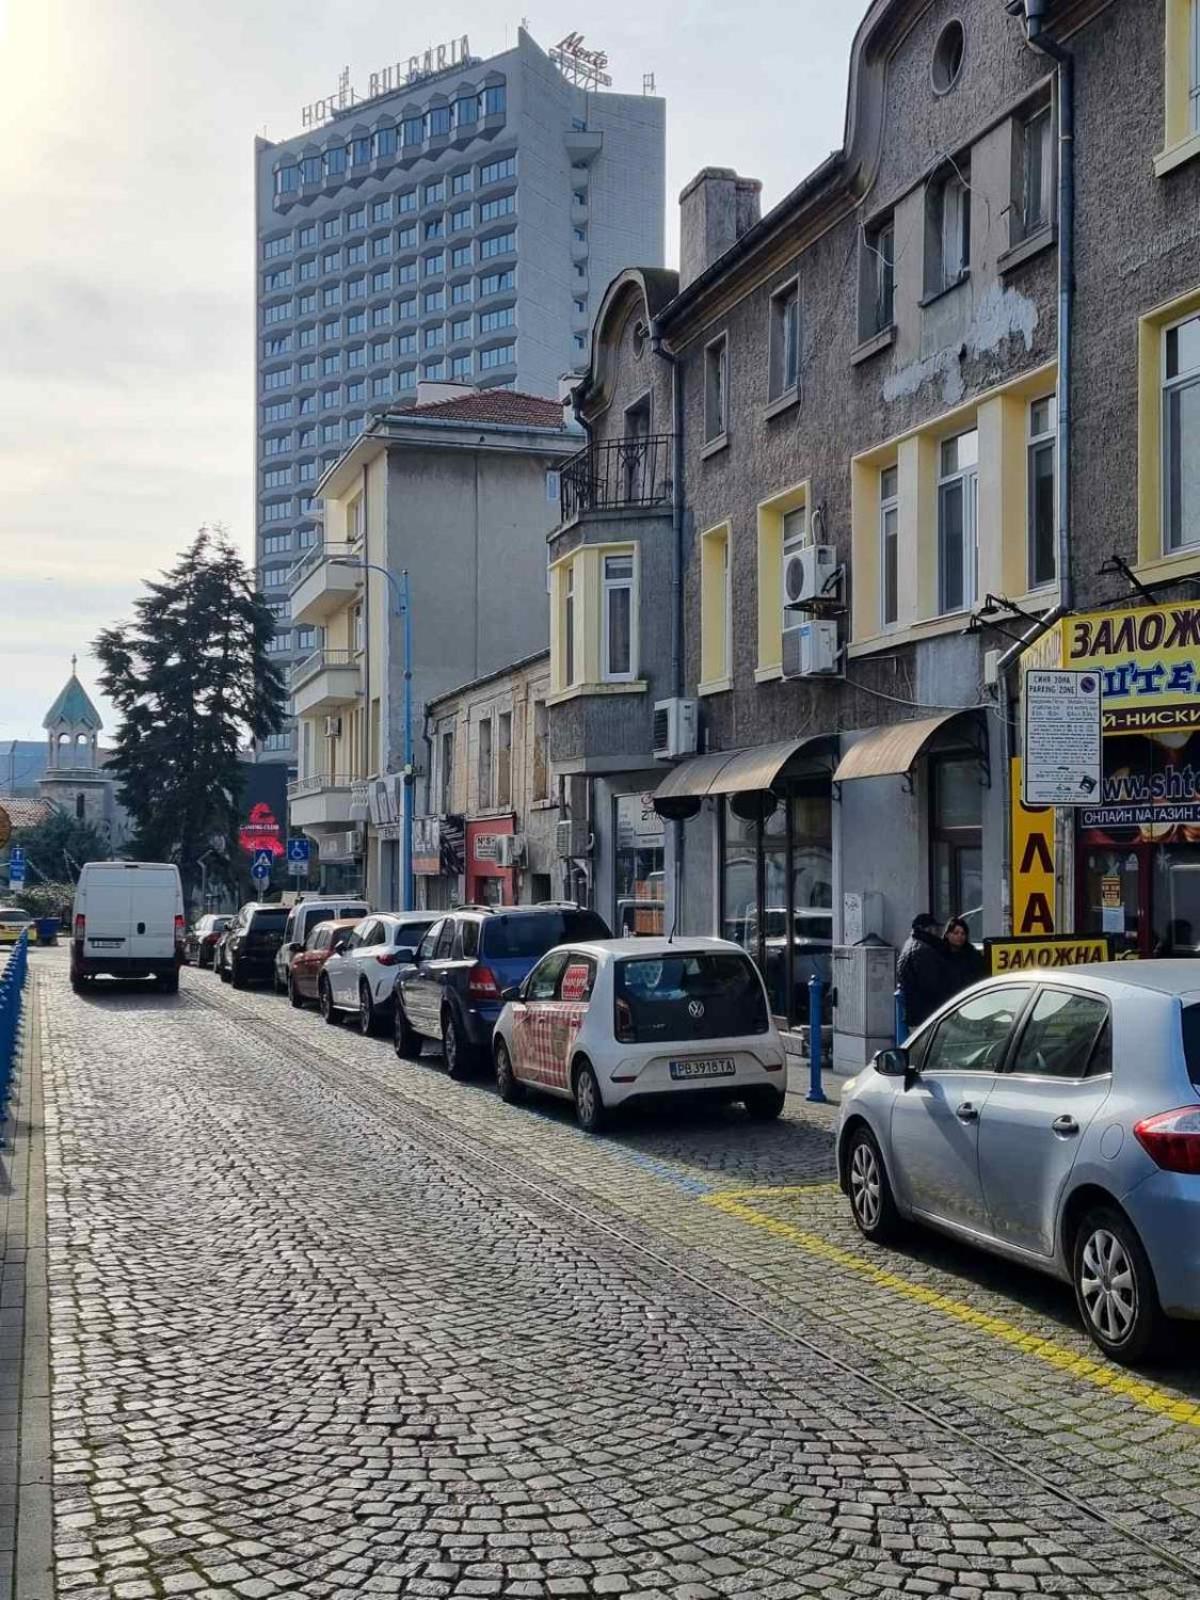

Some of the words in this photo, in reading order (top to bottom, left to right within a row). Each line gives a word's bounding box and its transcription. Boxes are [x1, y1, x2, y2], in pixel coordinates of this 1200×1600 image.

[369, 34, 469, 99] BULGARIA
[1084, 808, 1132, 825] ОНЛАЙН
[997, 946, 1103, 970] ЗАЛОЖНА
